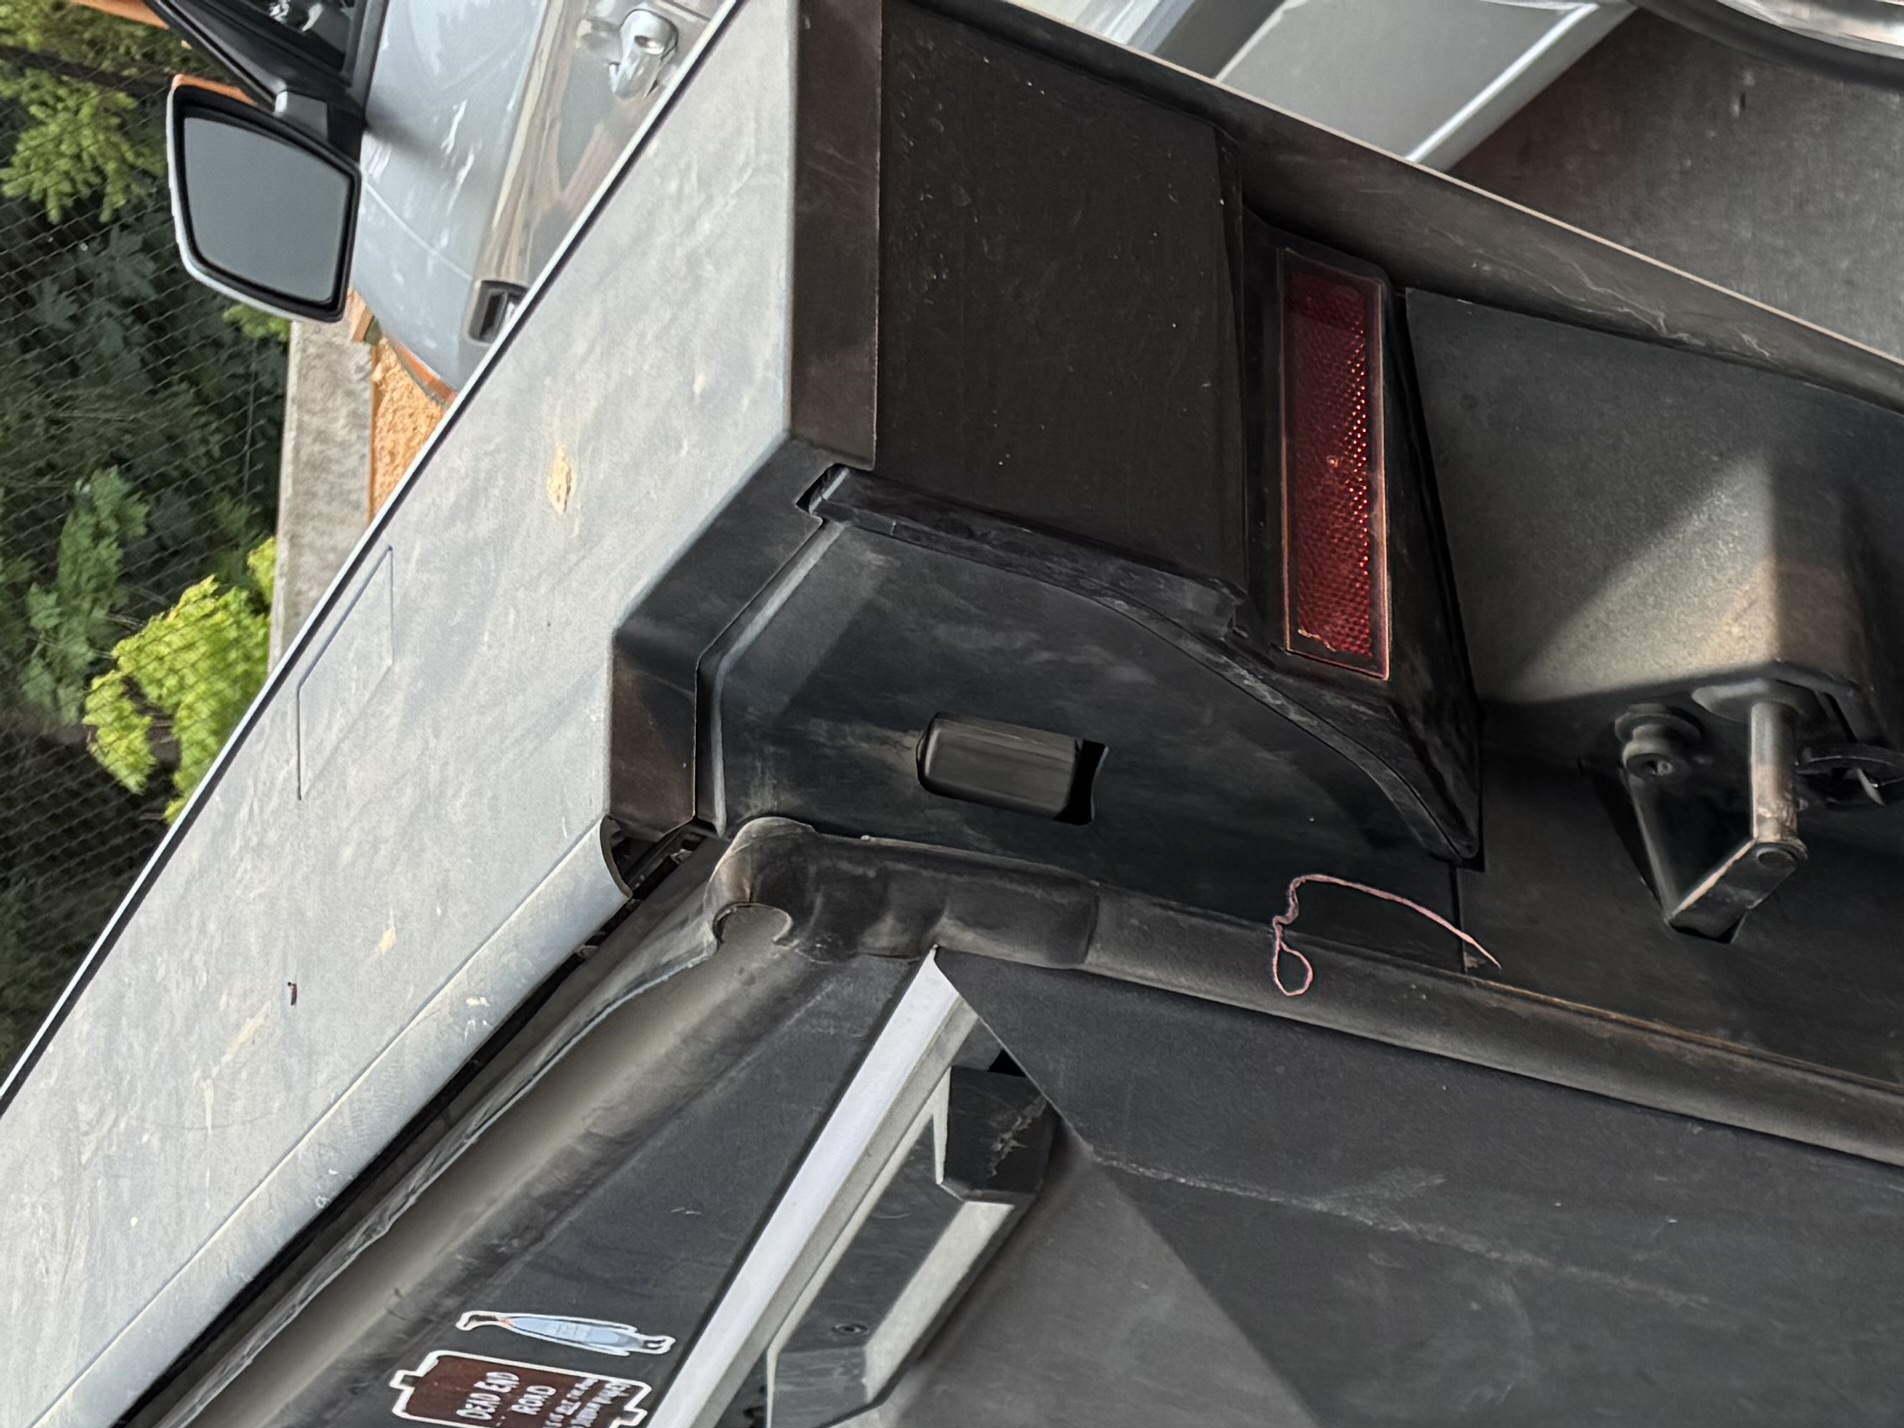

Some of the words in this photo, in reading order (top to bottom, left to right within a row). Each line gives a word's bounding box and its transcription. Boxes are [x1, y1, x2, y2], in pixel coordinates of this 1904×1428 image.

[474, 1372, 520, 1393] END
[456, 1393, 501, 1420] DEAD
[511, 1385, 556, 1415] ROAD
